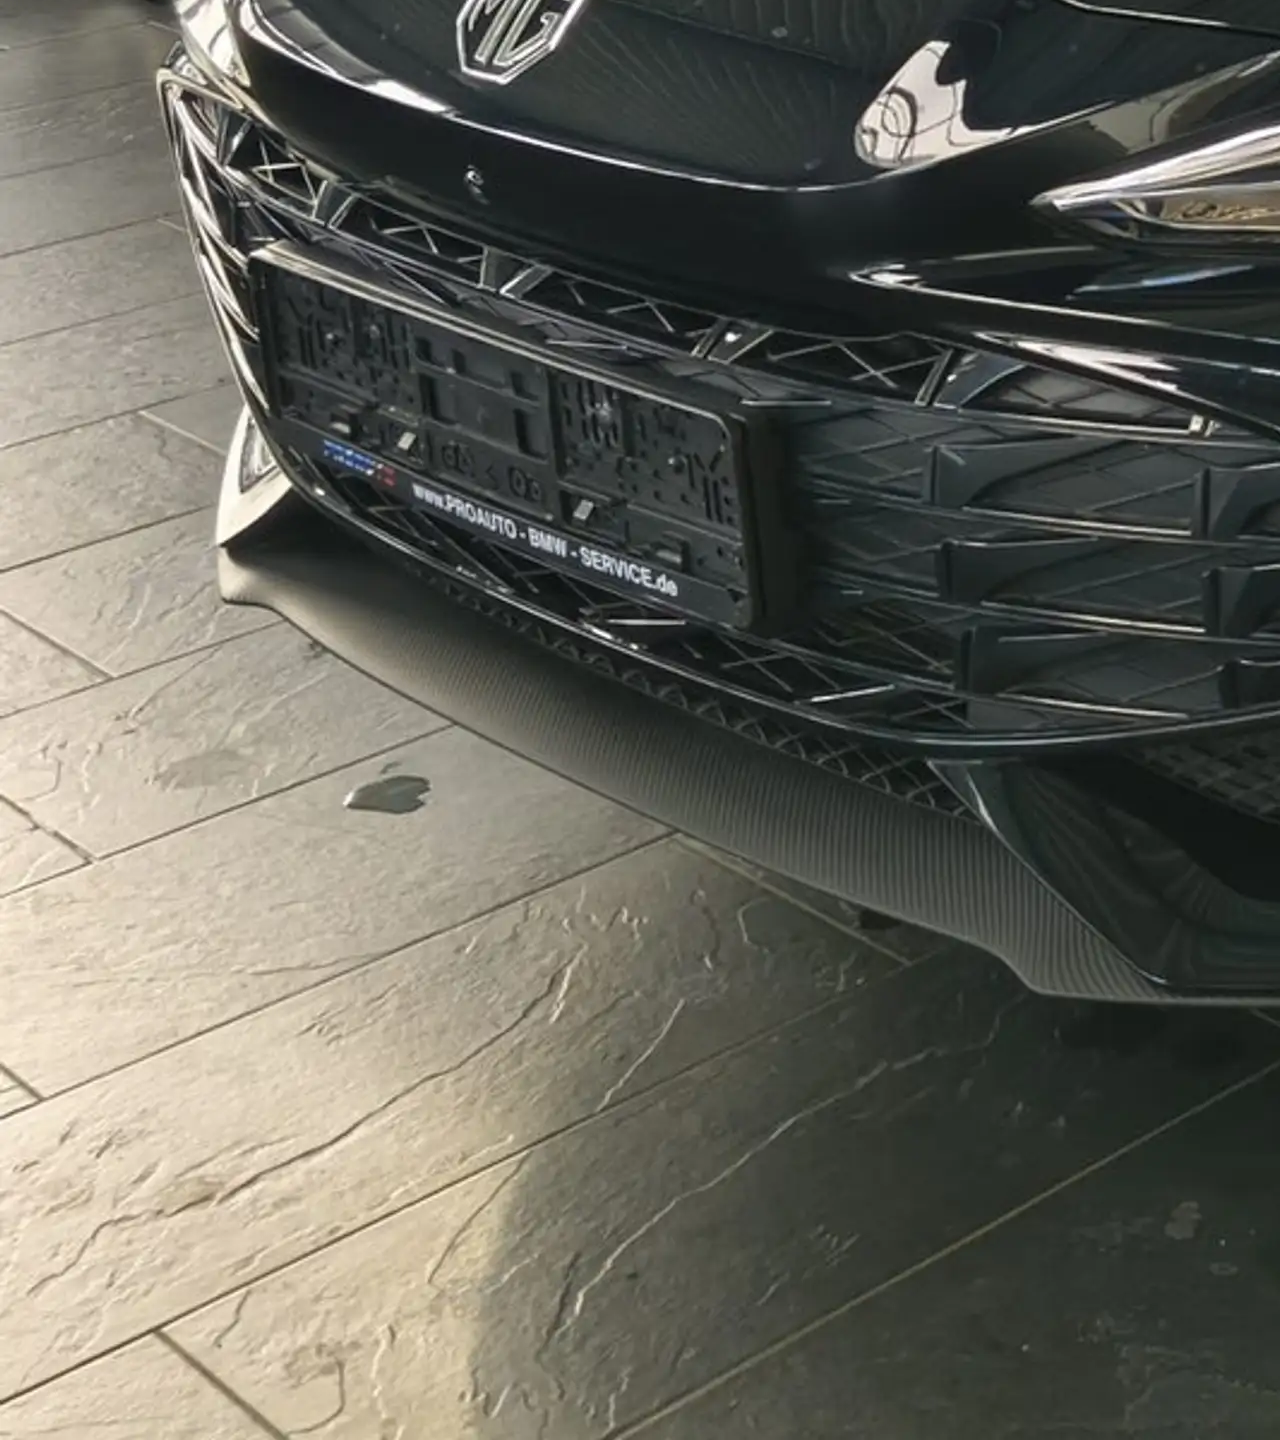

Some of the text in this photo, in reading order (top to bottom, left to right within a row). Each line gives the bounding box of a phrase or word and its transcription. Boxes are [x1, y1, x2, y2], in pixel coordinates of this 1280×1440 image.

[411, 482, 518, 540] www.PROAUTO
[528, 526, 568, 558] BMW
[579, 546, 678, 597] SERVICE.de
